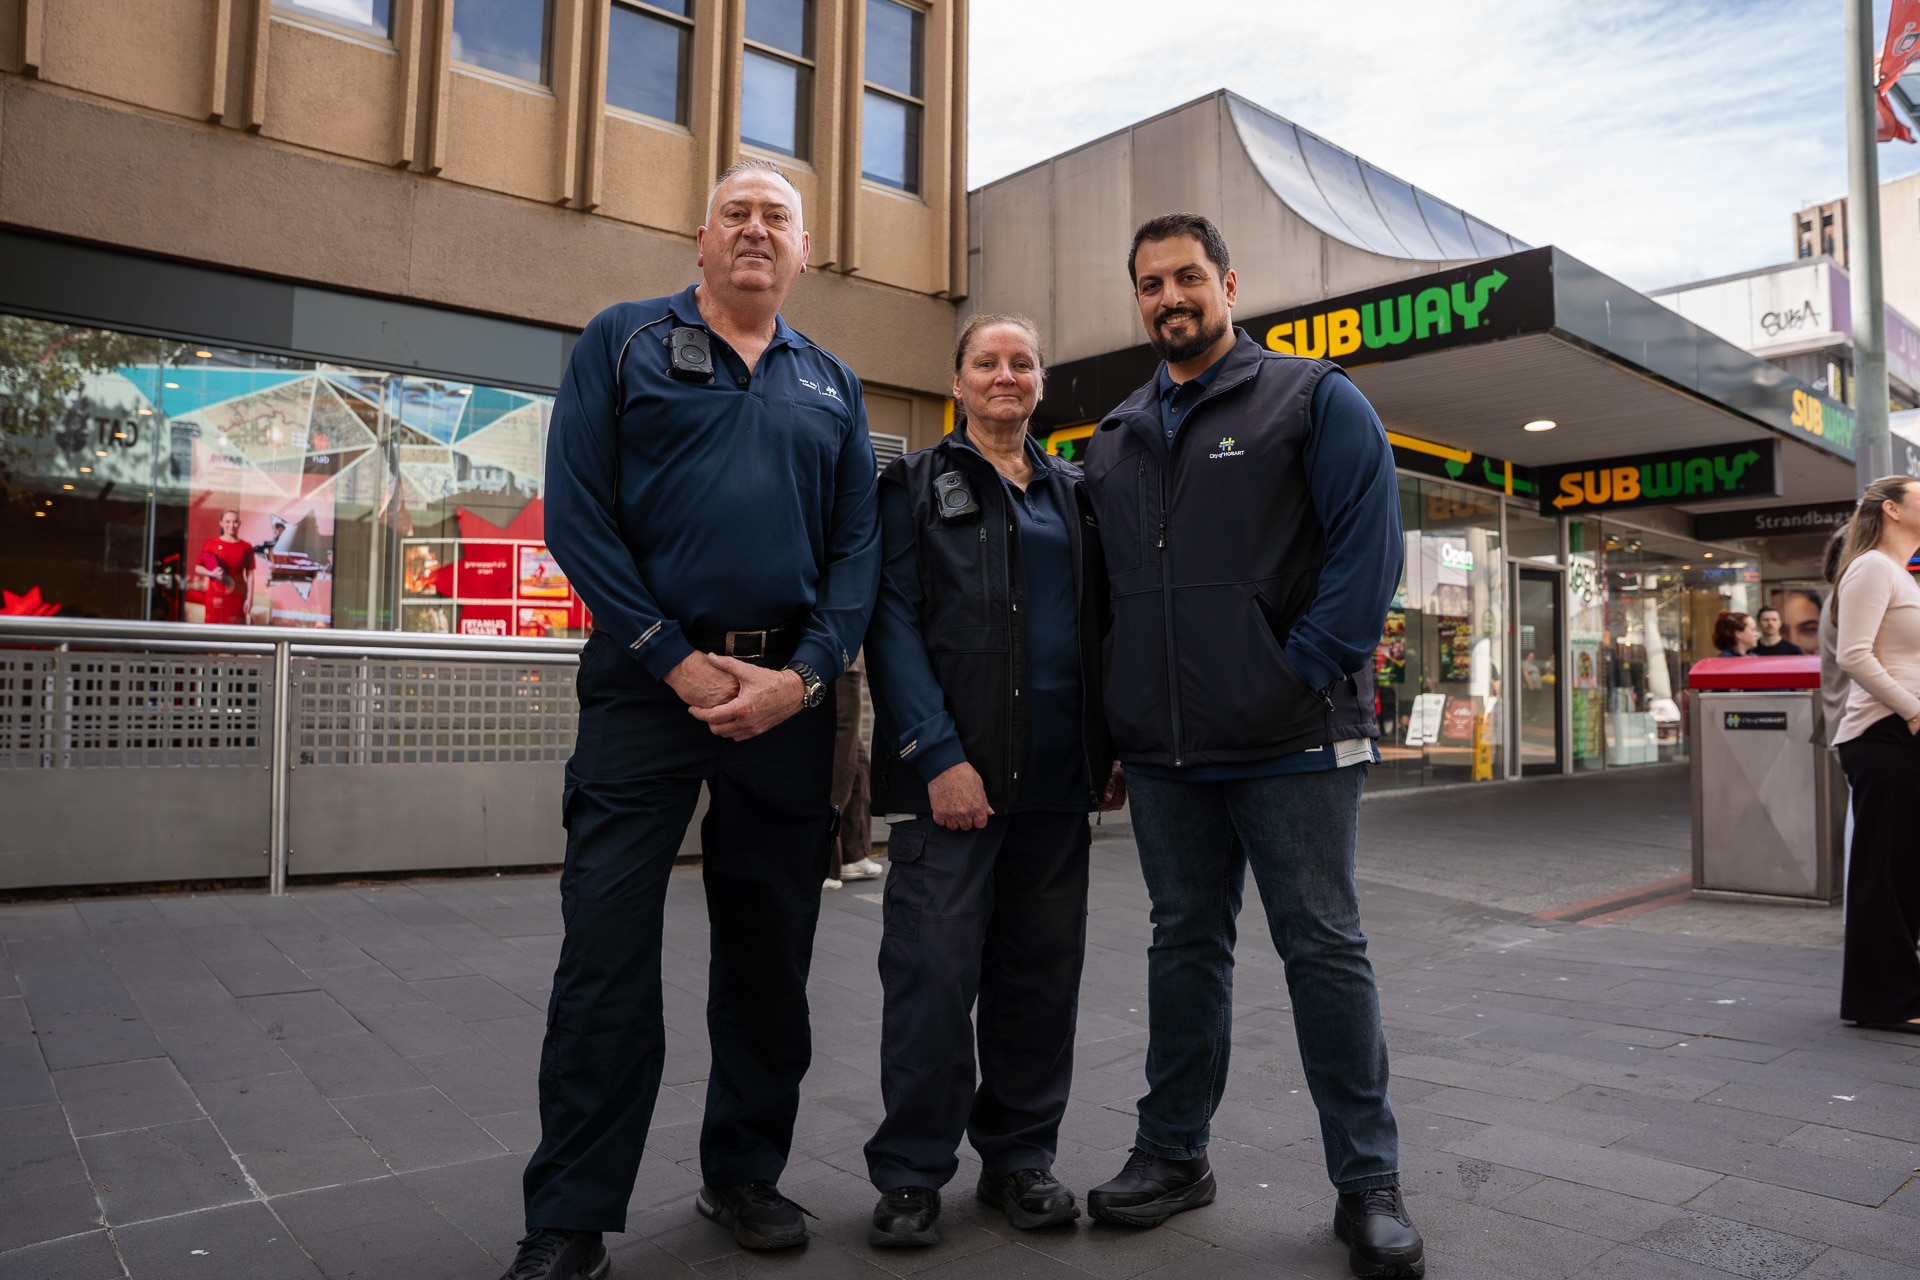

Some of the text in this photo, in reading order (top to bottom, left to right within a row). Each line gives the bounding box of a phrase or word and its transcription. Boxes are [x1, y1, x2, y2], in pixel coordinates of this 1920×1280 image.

[1266, 269, 1508, 359] SUBWAY
[1898, 327, 1920, 360] JU
[1790, 389, 1856, 450] SUBWAY
[312, 455, 330, 464] nab
[1552, 449, 1760, 510] SUBWAY
[1441, 543, 1473, 568] Open
